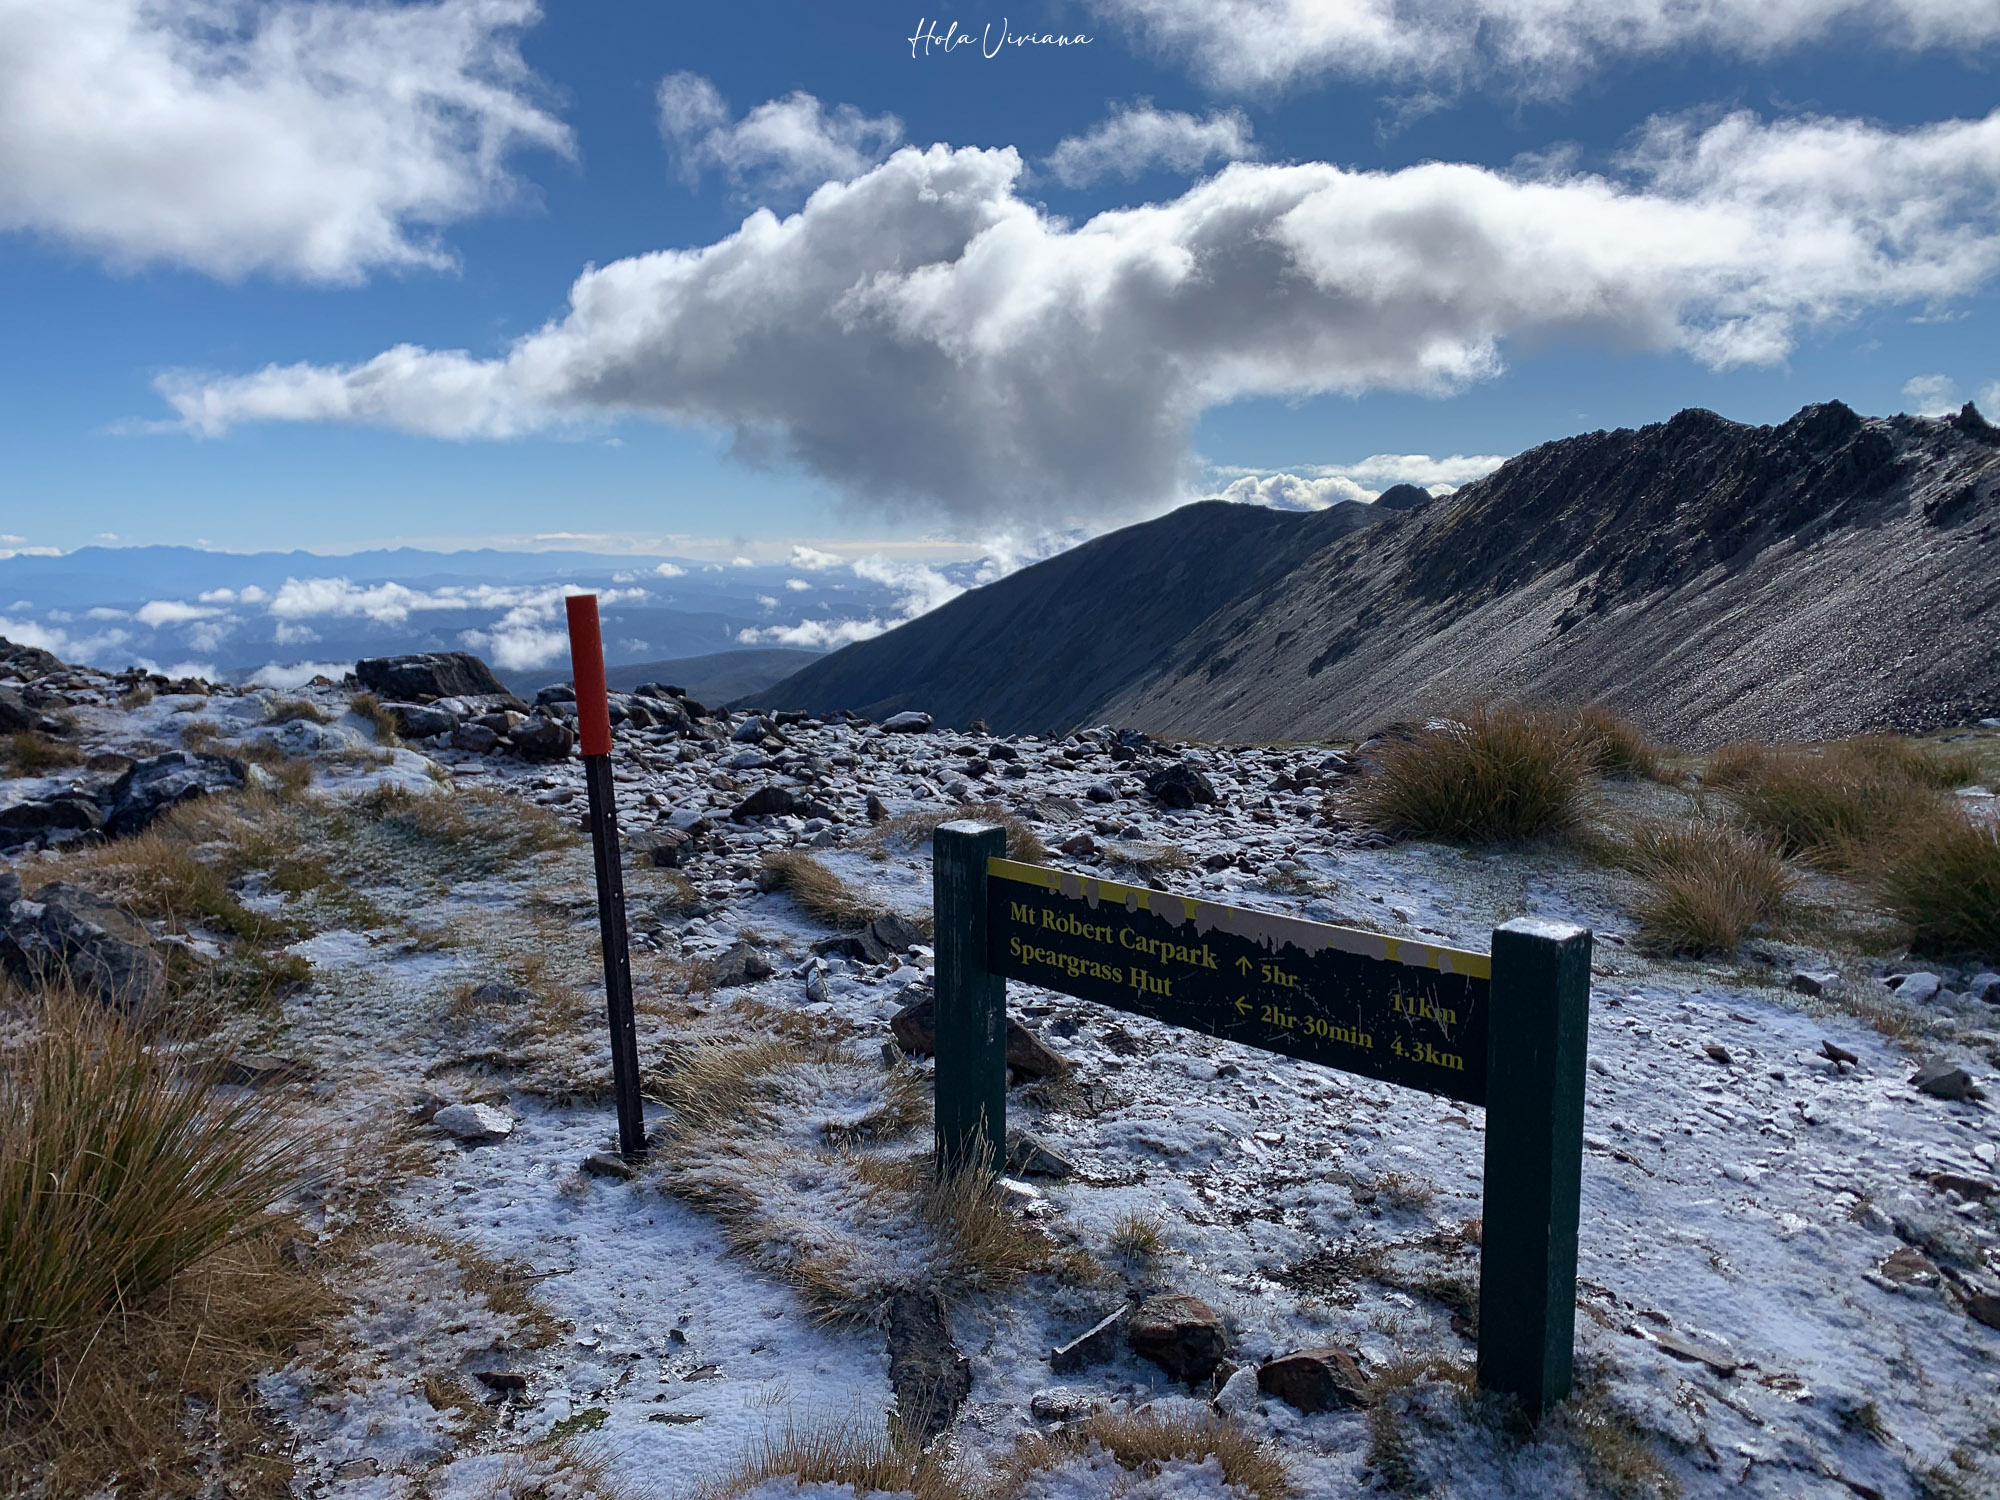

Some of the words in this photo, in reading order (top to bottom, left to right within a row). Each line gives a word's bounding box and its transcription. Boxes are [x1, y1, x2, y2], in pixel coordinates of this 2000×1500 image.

[1010, 901, 1036, 926] Mt
[1041, 908, 1114, 944] Robert
[1119, 927, 1218, 970] Carpark
[1260, 964, 1299, 988] 5hr
[1391, 993, 1458, 1025] 11km
[1010, 936, 1123, 984] Speargrass
[1128, 966, 1173, 997] Hut
[1260, 1004, 1298, 1029] 2hr
[1303, 1014, 1374, 1049] 30min
[1390, 1035, 1465, 1070] 4.3km
